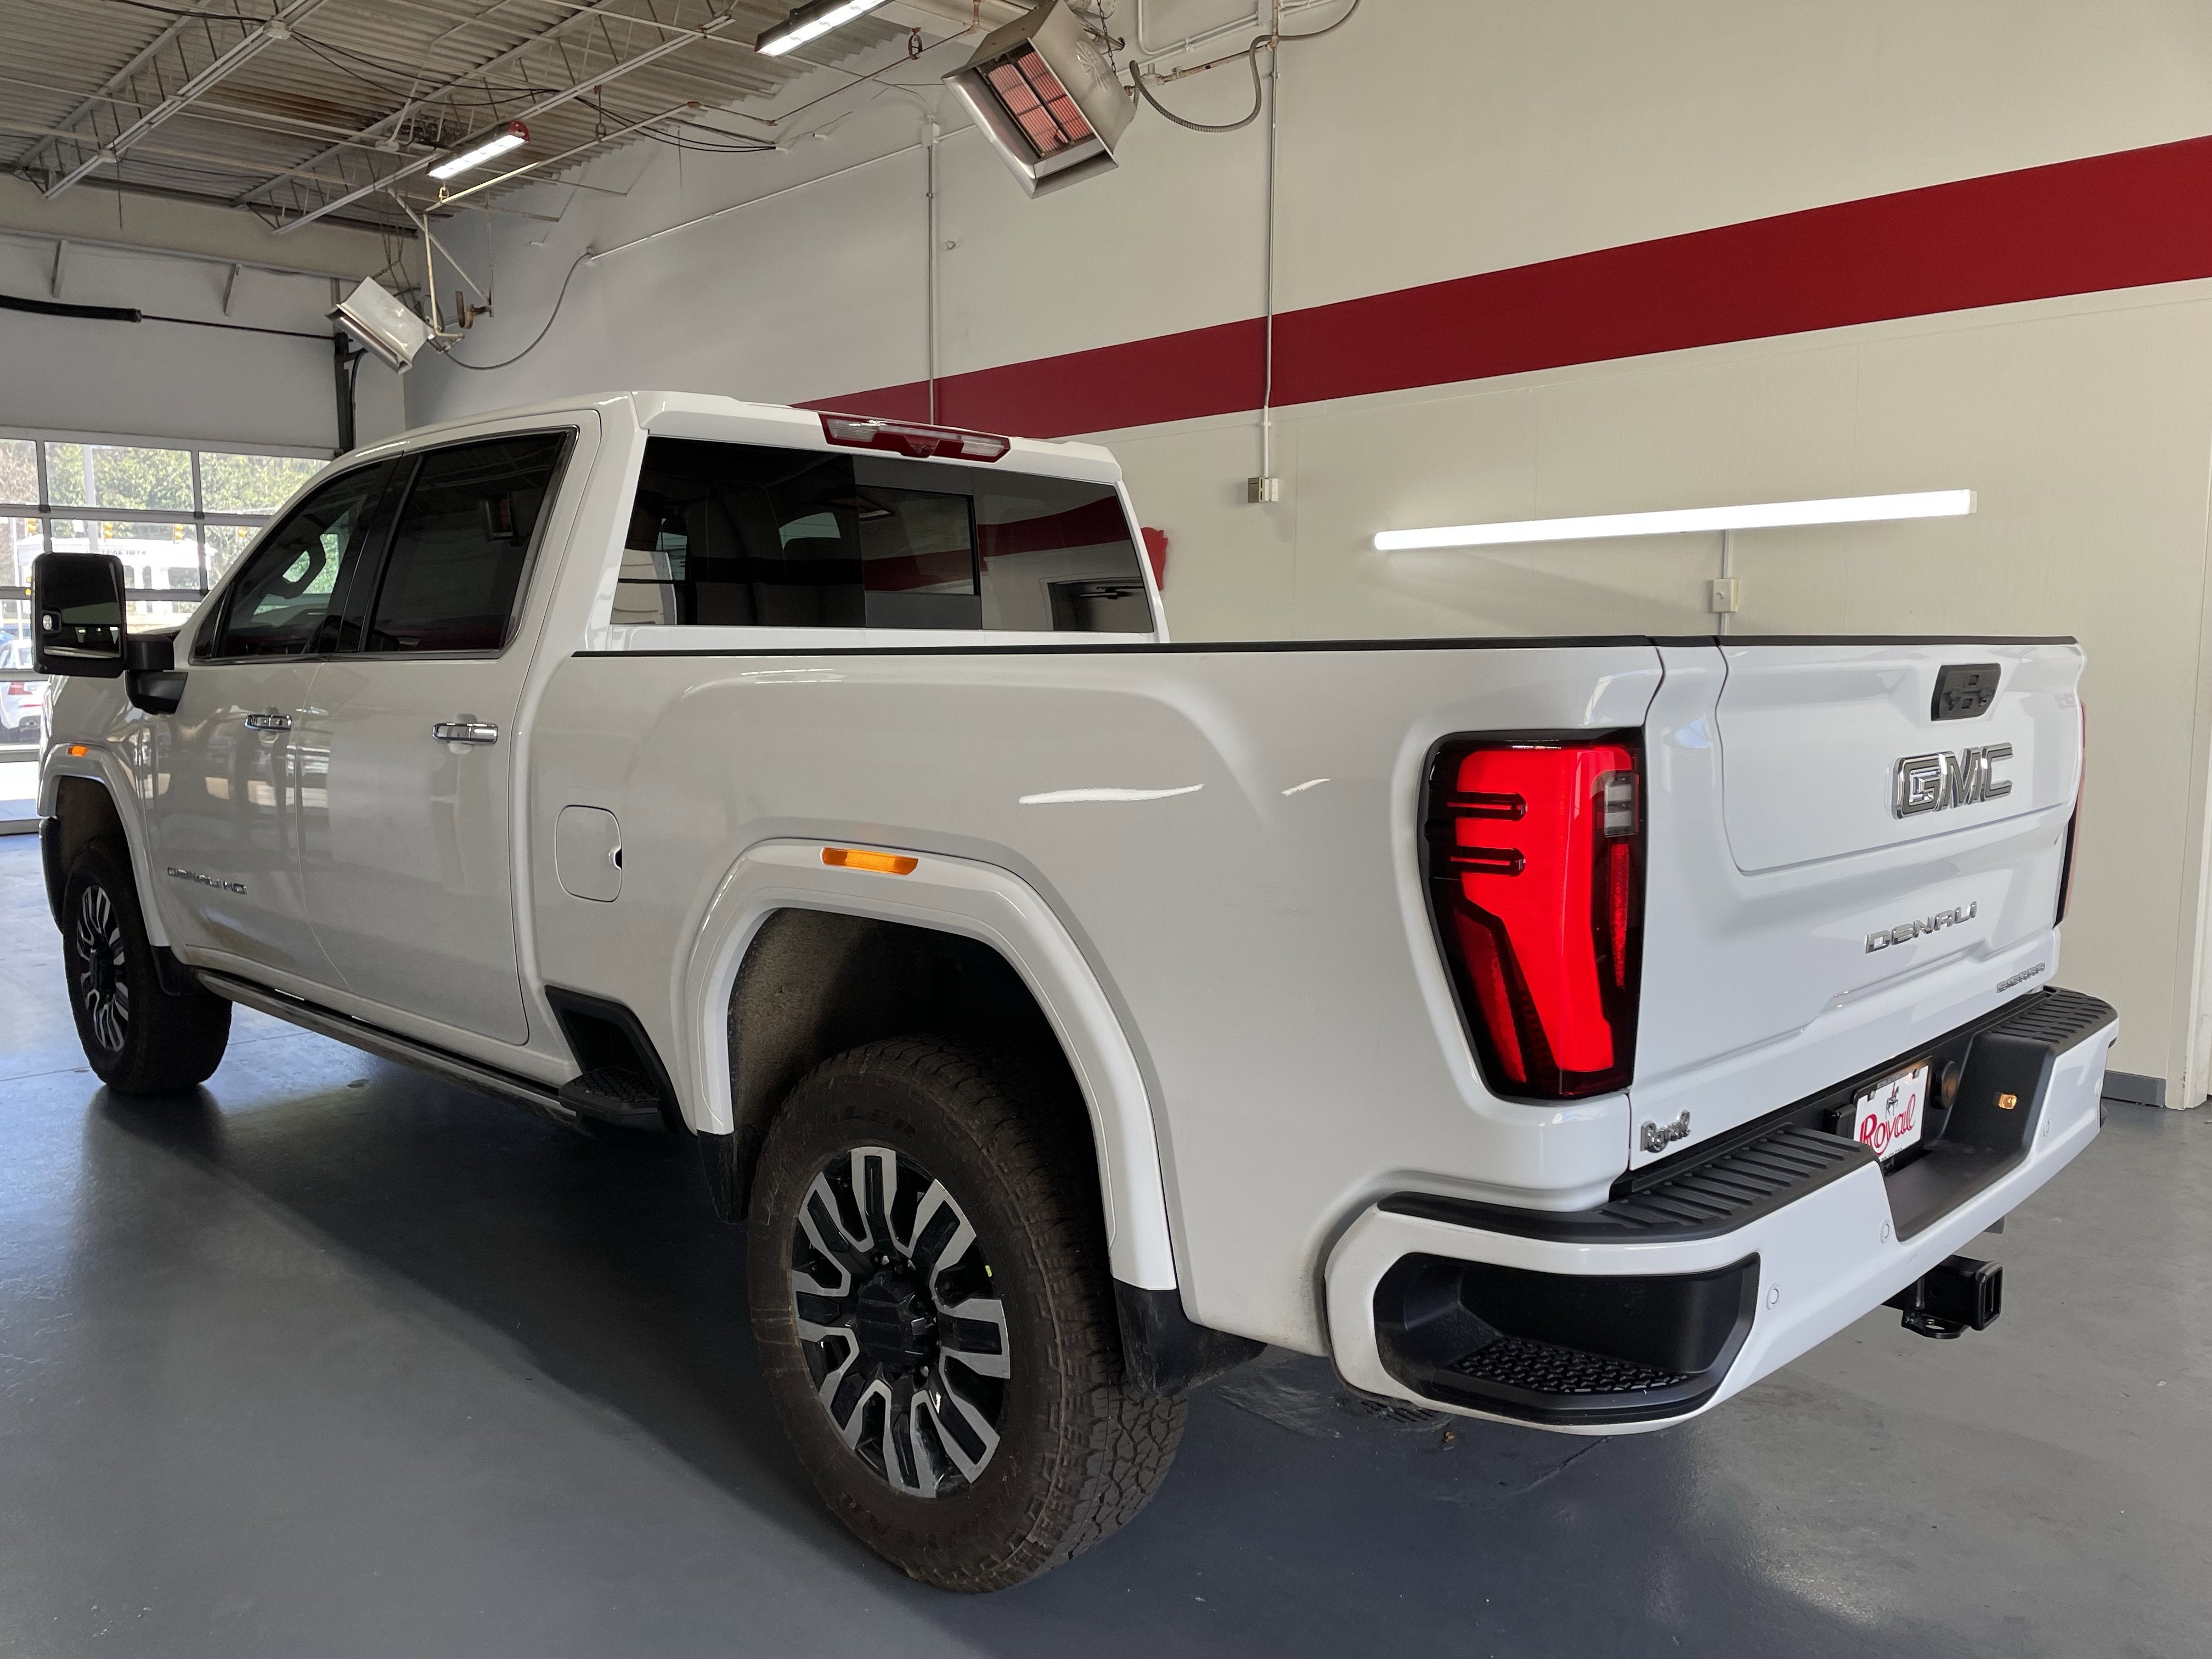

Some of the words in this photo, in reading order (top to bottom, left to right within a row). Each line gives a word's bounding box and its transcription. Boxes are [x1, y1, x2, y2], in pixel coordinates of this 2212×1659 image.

[1892, 742, 2014, 820] GMC
[1865, 901, 1977, 954] DENALI
[1996, 962, 2046, 993] SIERRA
[1640, 1109, 1691, 1153] Royal
[1860, 1093, 1916, 1158] Royal
